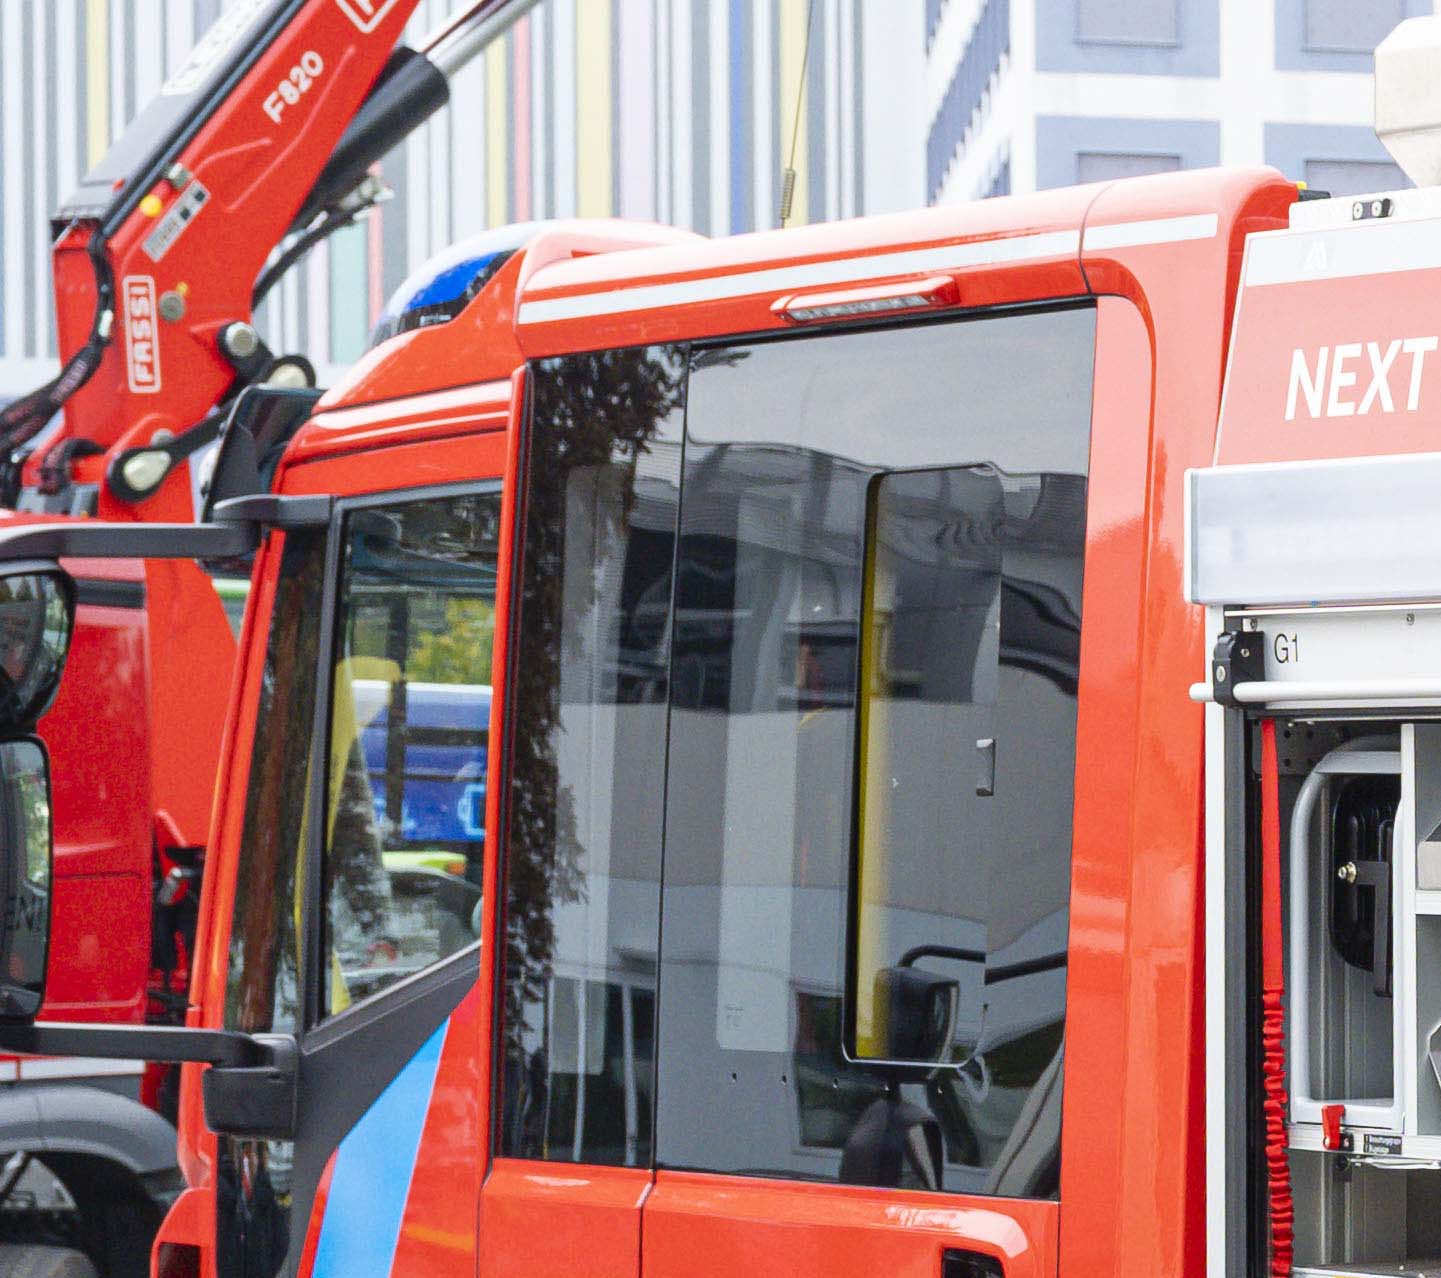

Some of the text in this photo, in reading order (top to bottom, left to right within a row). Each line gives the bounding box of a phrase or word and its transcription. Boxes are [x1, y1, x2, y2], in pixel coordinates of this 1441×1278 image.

[262, 50, 324, 125] F820
[133, 280, 151, 384] FASSI
[1285, 332, 1438, 420] NEXT
[1274, 633, 1299, 664] G1
